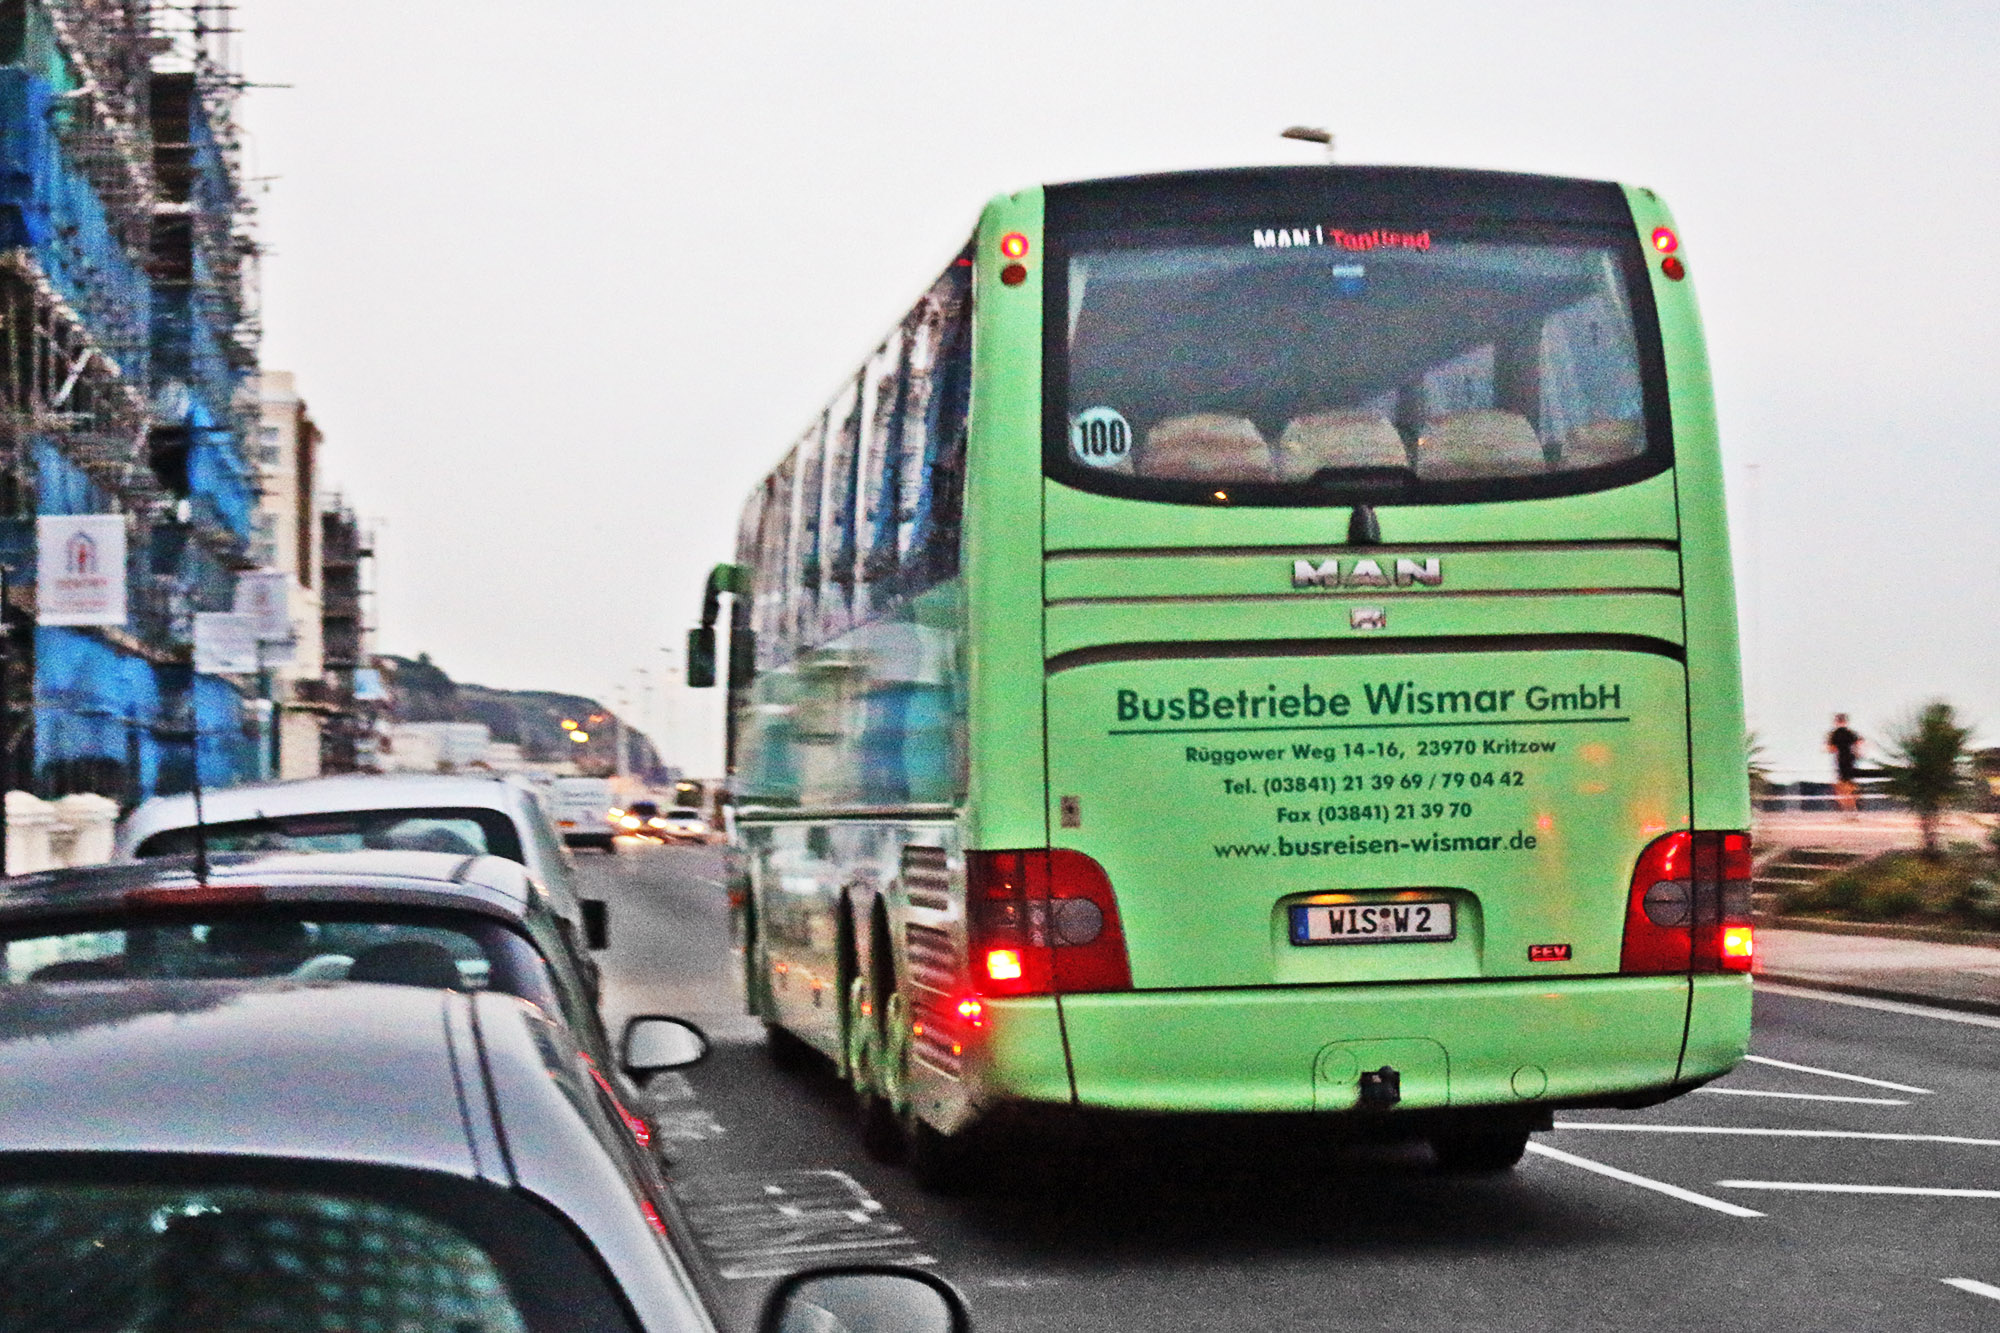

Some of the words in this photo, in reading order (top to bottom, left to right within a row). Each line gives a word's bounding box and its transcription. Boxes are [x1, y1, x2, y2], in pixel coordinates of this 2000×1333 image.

[1253, 229, 1310, 248] MAN
[1081, 418, 1125, 456] 100
[1292, 558, 1443, 587] MAN
[1117, 684, 1351, 721] BusBetriebe
[1363, 681, 1515, 715] Wismar
[1525, 684, 1621, 711] GmbH
[1186, 746, 1284, 765] Rüggower
[1291, 744, 1335, 763] Weg
[1343, 742, 1406, 760] 14-16,
[1417, 740, 1476, 756] 23970
[1482, 738, 1556, 754] Kritzow
[1223, 778, 1257, 795] Tel.
[1264, 776, 1336, 797] (03841)
[1343, 774, 1363, 791] 21
[1371, 774, 1395, 790] 39
[1400, 773, 1423, 789] 69
[1441, 772, 1465, 788] 79
[1470, 771, 1495, 788] 04
[1499, 770, 1525, 787] 42
[1276, 807, 1311, 823] Fax
[1318, 805, 1390, 825] (03841)
[1395, 804, 1415, 820] 21
[1421, 803, 1444, 819] 39
[1449, 802, 1473, 818] 70
[1213, 830, 1537, 857] www.busreisen-wismar.de
[1328, 908, 1378, 935] WIS
